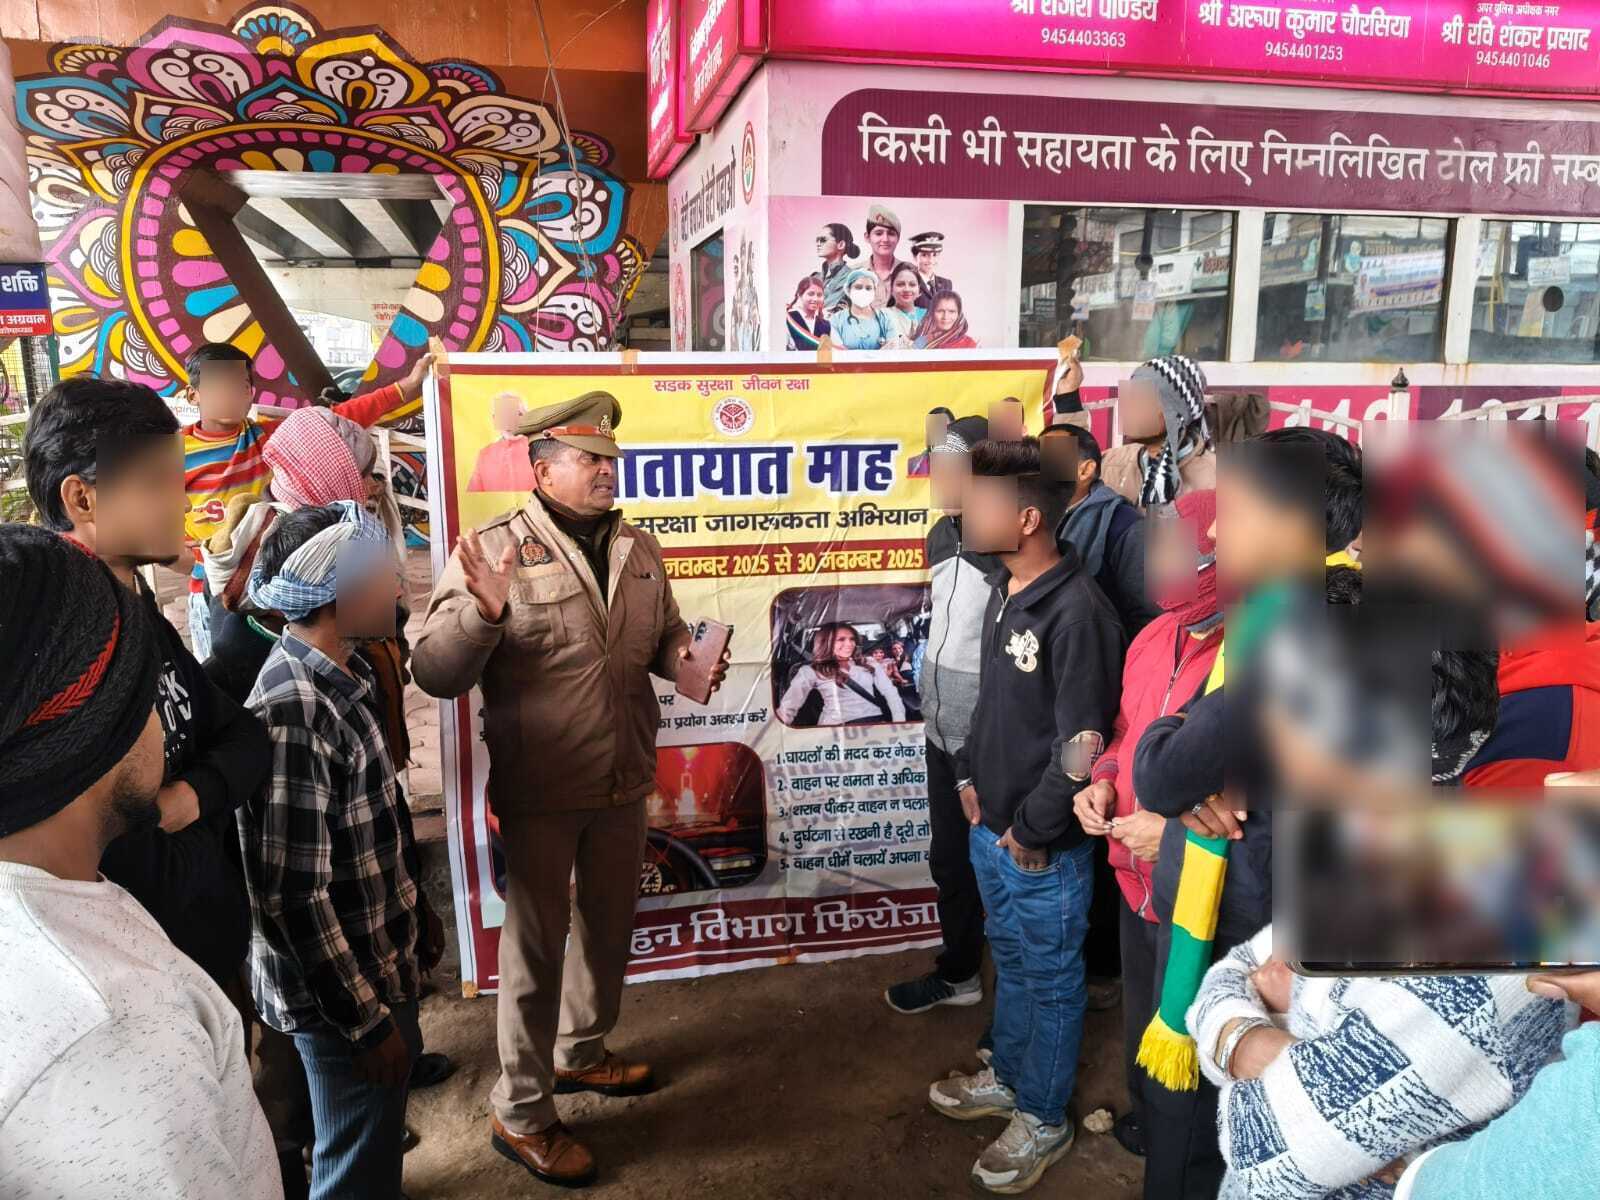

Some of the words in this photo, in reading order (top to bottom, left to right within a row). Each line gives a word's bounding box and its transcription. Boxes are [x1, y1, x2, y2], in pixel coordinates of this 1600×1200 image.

[1041, 0, 1093, 18] राजश
[1099, 0, 1159, 21] पाण्डय
[1198, 0, 1223, 26] श्री
[1284, 8, 1337, 40] कुमार
[1341, 4, 1411, 39] चौरसिया
[1040, 28, 1126, 48] 9454403363
[1441, 15, 1465, 45] श्री
[1467, 16, 1493, 47] रवि
[1499, 22, 1543, 50] शंकर
[1547, 28, 1592, 52] प्रसाद
[1264, 42, 1343, 62] 9454401253
[1476, 51, 1551, 69] 9454401046
[857, 112, 952, 166] किसी
[963, 116, 1006, 167] भी
[1014, 131, 1136, 174] सहायता
[1143, 124, 1180, 173] के
[1187, 127, 1253, 186] लिए
[1260, 129, 1430, 181] निम्नलिखित
[1503, 140, 1546, 185] फ्री
[1552, 154, 1600, 187] नम्ब
[1, 270, 38, 293] शक्ति
[697, 378, 733, 396] सुरक्षा
[743, 375, 782, 392] जीवन
[787, 378, 809, 392] रक्षा
[618, 446, 793, 498] ातायात
[807, 444, 898, 492] माह
[633, 516, 698, 534] सरक्षा
[836, 502, 928, 527] अभियान
[665, 556, 730, 578] नवम्बर
[733, 553, 769, 575] 2025
[774, 546, 795, 573] से
[797, 552, 817, 572] 30
[820, 550, 883, 572] नवम्बर
[888, 548, 923, 568] 2025
[659, 695, 675, 705] पर
[674, 713, 706, 730] प्रयोग
[748, 708, 768, 723] करें
[825, 744, 840, 762] की
[844, 747, 869, 761] मदद
[873, 746, 892, 760] कर
[791, 777, 821, 792] वाहन
[825, 775, 840, 789] पर
[843, 774, 874, 788] क्षमता
[878, 769, 888, 786] से
[892, 767, 925, 785] अधिक
[858, 801, 887, 815] वाहन
[890, 800, 900, 812] न
[793, 827, 831, 850] दुर्घटना
[849, 822, 881, 841] रखनी
[884, 820, 892, 838] है
[896, 819, 916, 845] दूरी
[918, 819, 929, 837] तो
[793, 856, 825, 873] वाहन
[888, 852, 921, 865] अपना
[690, 909, 807, 944] विभाग
[814, 897, 941, 934] फिरोजा
